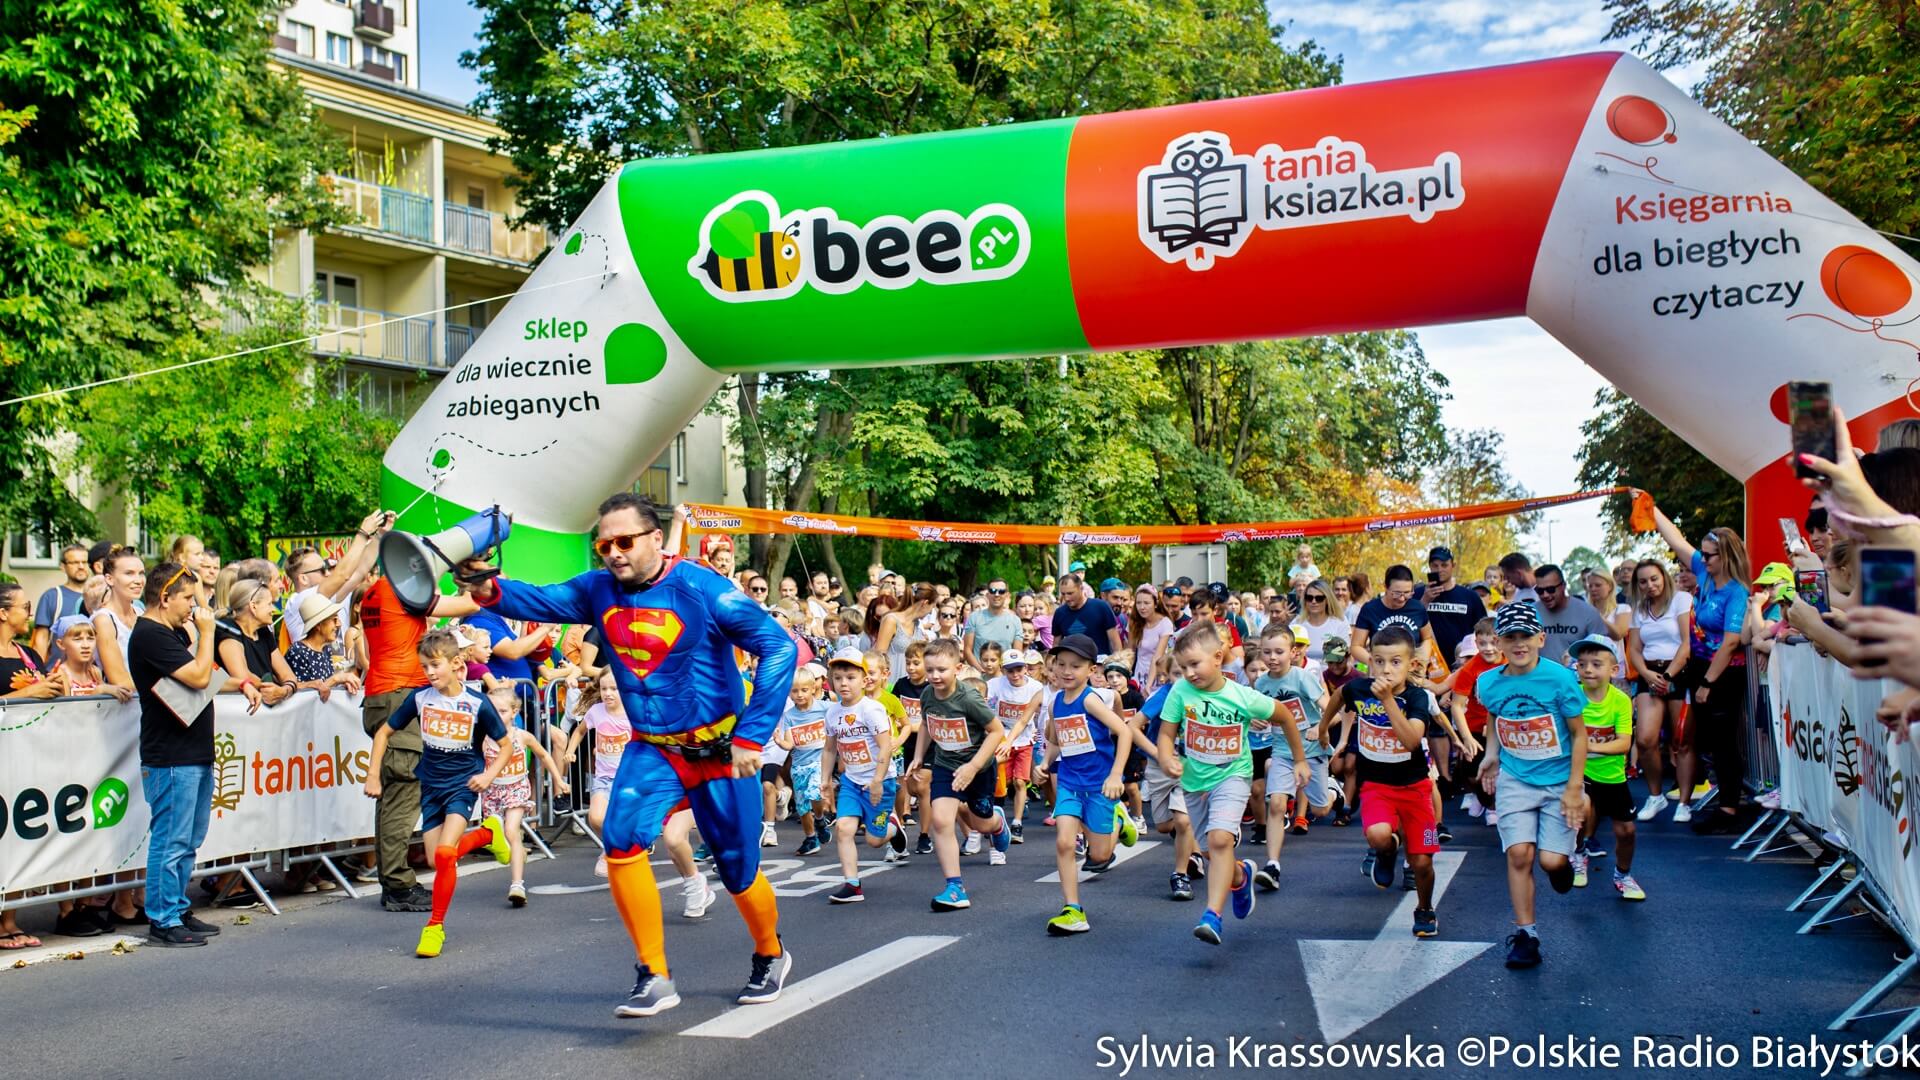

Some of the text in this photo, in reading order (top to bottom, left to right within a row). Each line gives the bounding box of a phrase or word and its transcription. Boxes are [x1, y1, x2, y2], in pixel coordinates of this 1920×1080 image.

[1262, 145, 1356, 183] tania
[1264, 161, 1455, 221] ksiazka.pl
[1615, 191, 1793, 225] Księgarnia
[1593, 228, 1801, 276] dla biegłych
[1652, 280, 1805, 320] czytaczy
[523, 317, 588, 343] Sklep
[455, 353, 592, 385] dla wiecznie
[446, 390, 601, 421] zabieganych
[700, 519, 741, 528] KIDS RUN
[1543, 623, 1579, 635] mbro
[429, 720, 469, 738] 4355
[934, 728, 965, 741] 4041
[1195, 735, 1238, 751] 4046
[1508, 729, 1553, 746] 4029
[0, 783, 89, 842] ee
